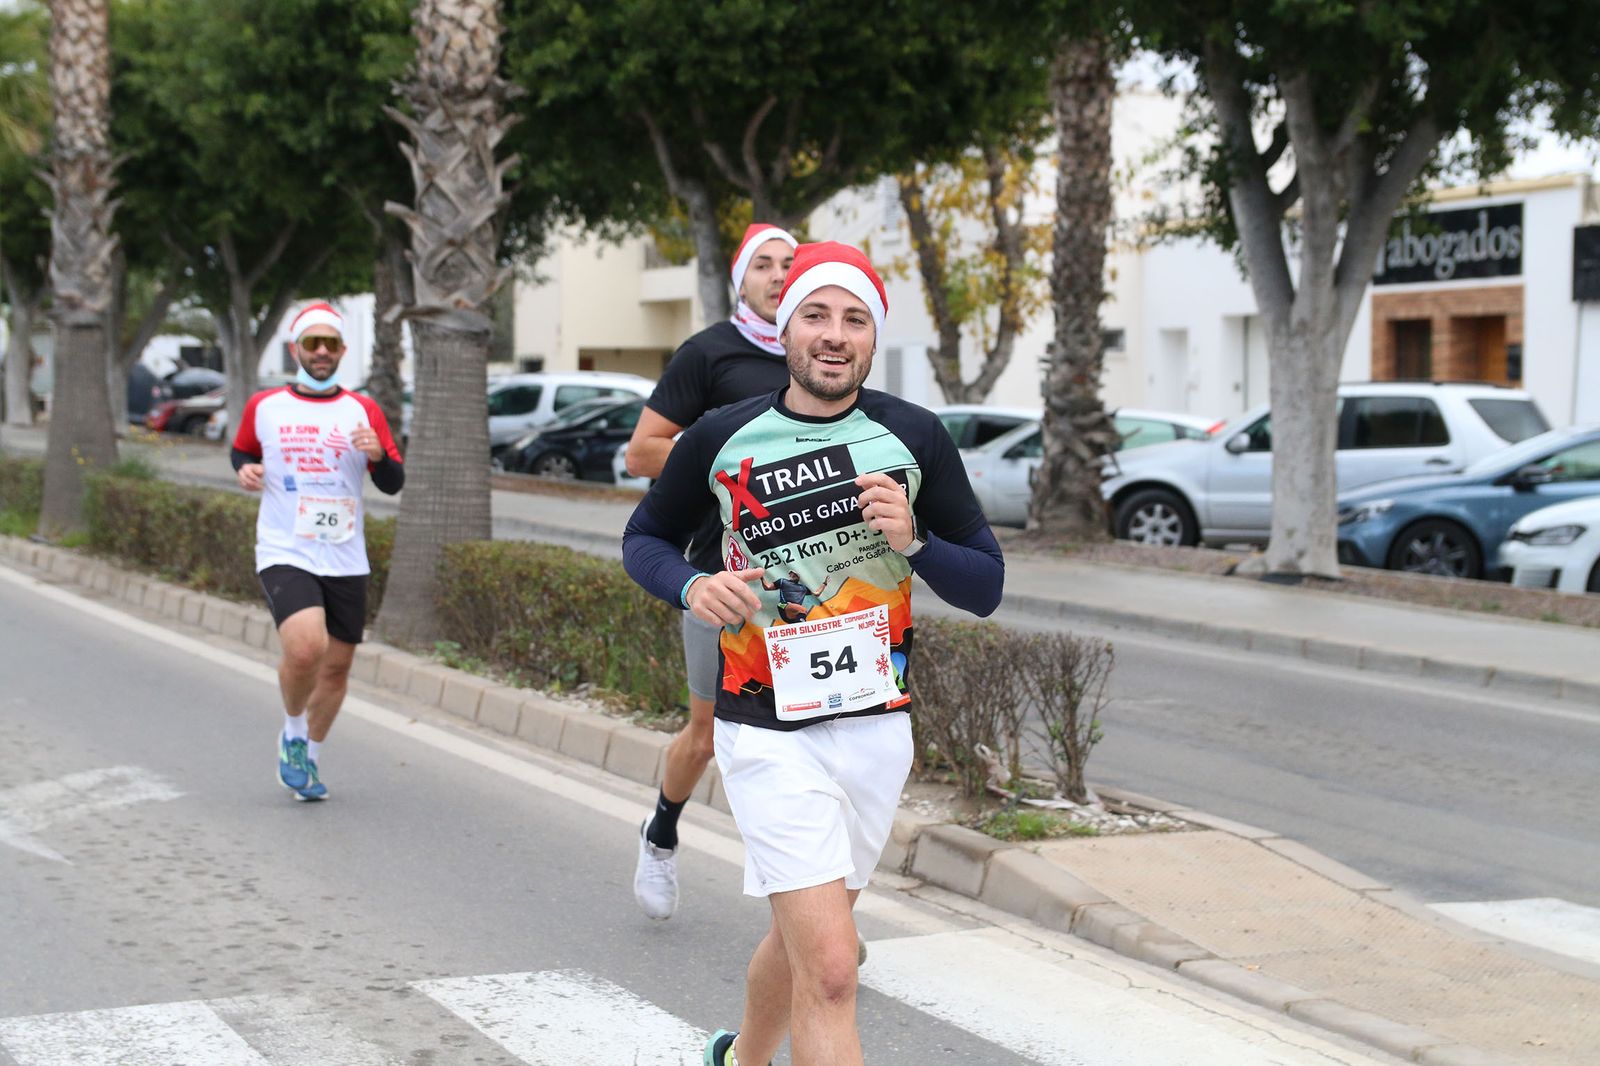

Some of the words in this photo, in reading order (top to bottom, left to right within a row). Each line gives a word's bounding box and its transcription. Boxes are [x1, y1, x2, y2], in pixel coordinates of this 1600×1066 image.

[1387, 210, 1521, 280] abogados
[715, 457, 770, 532] X
[756, 456, 841, 496] TRAIL
[315, 512, 338, 527] 26
[743, 517, 785, 542] CABO
[789, 508, 813, 528] DE
[816, 495, 859, 520] GATA
[760, 548, 795, 571] 29,2
[797, 537, 833, 560] Km,
[836, 529, 867, 547] D+:
[826, 560, 851, 573] Cabo
[852, 555, 865, 565] de
[866, 547, 886, 560] Gata
[768, 630, 779, 639] XII
[780, 627, 798, 637] SAN
[799, 620, 843, 635] SILVESTRE
[810, 645, 858, 680] 54
